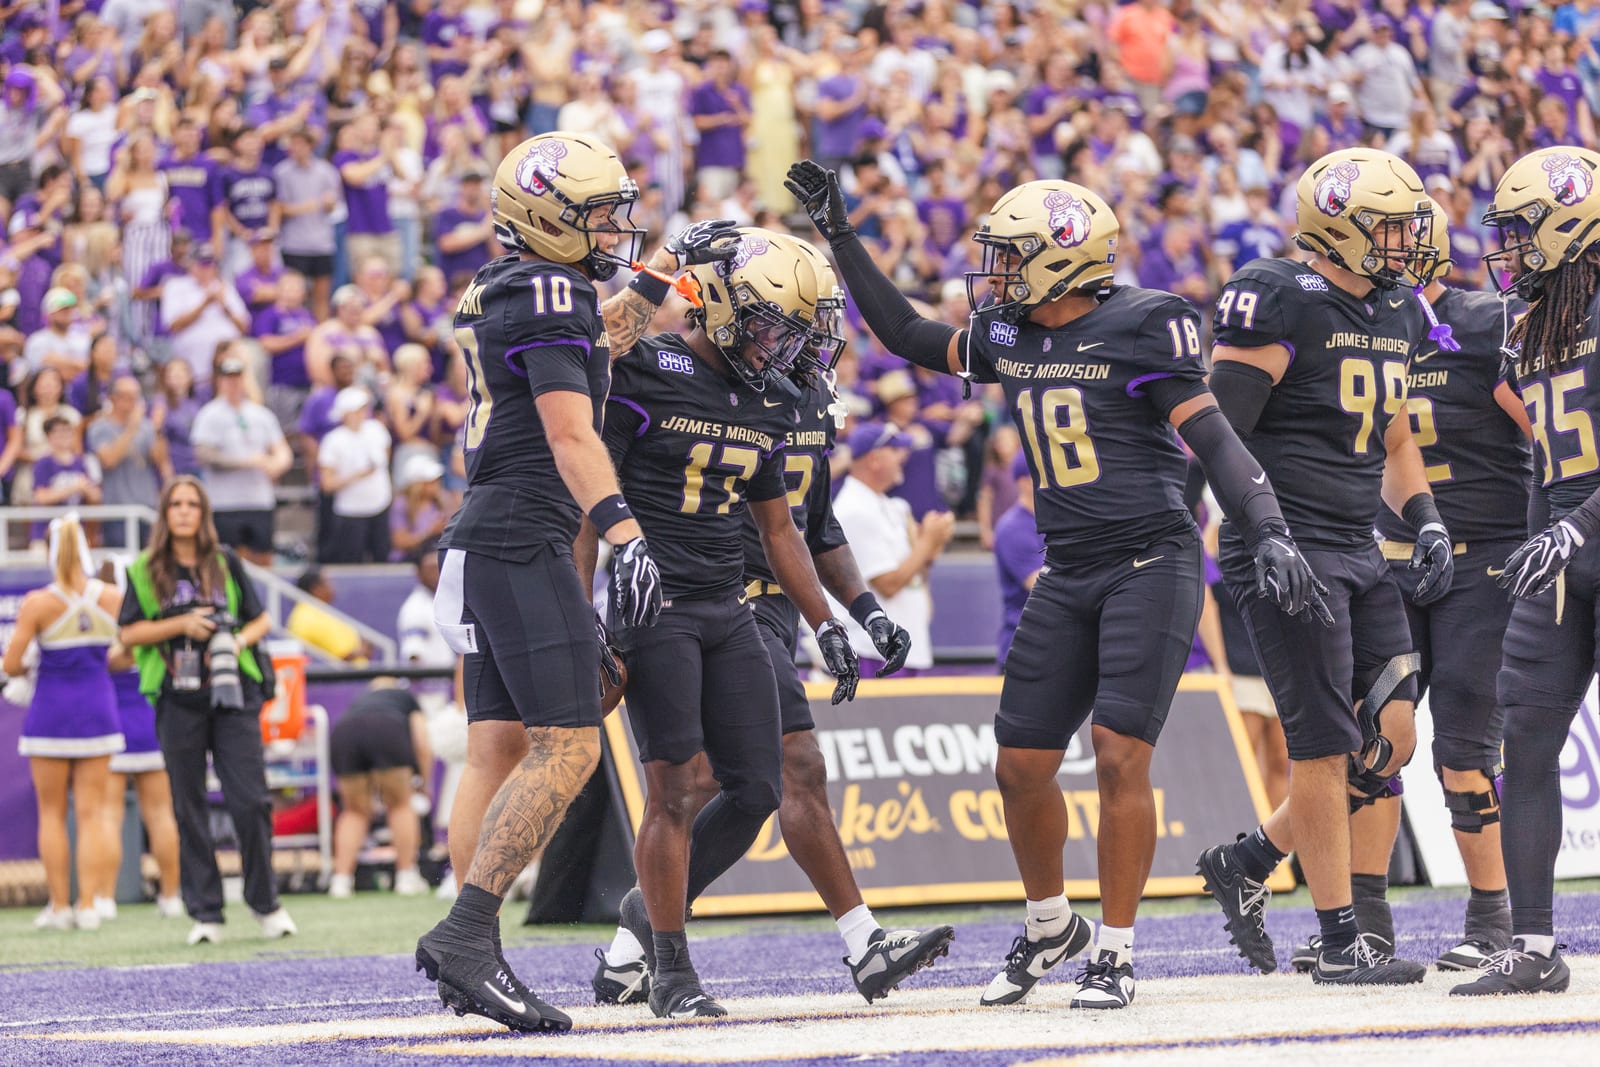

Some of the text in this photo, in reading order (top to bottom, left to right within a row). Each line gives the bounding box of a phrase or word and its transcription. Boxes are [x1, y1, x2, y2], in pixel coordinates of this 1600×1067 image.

[531, 274, 575, 316] 10
[1296, 274, 1328, 291] SBC
[1218, 288, 1259, 330] 99
[990, 320, 1018, 346] SBC
[1167, 316, 1200, 360] 18
[1326, 332, 1369, 349] JAMES
[658, 351, 694, 374] SBC
[995, 357, 1111, 380] JAMES MADISON
[1338, 355, 1408, 456] 99
[660, 416, 723, 437] JAMES
[725, 425, 774, 451] MADISON
[1017, 386, 1102, 489] 18
[680, 441, 761, 514] 17
